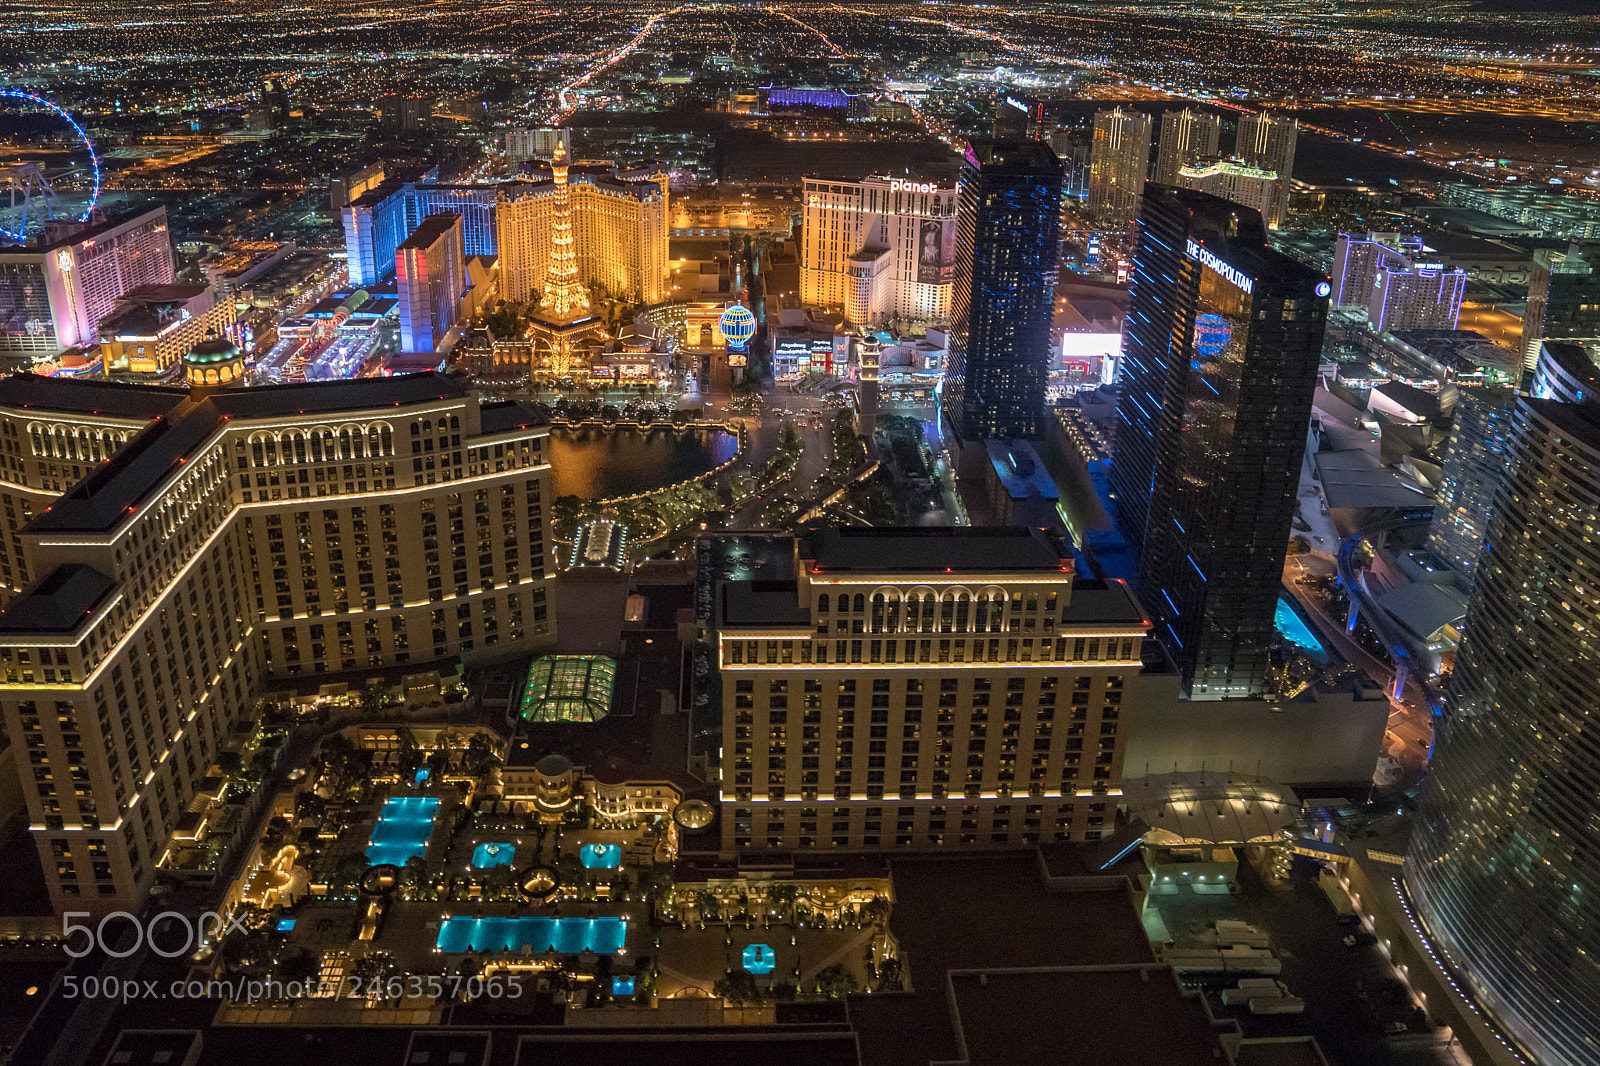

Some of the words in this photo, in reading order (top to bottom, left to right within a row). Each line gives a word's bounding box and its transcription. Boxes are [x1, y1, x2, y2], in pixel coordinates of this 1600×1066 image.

[891, 179, 938, 194] planet
[1186, 239, 1200, 259] THE
[1199, 248, 1253, 294] COSMOPOLITAN
